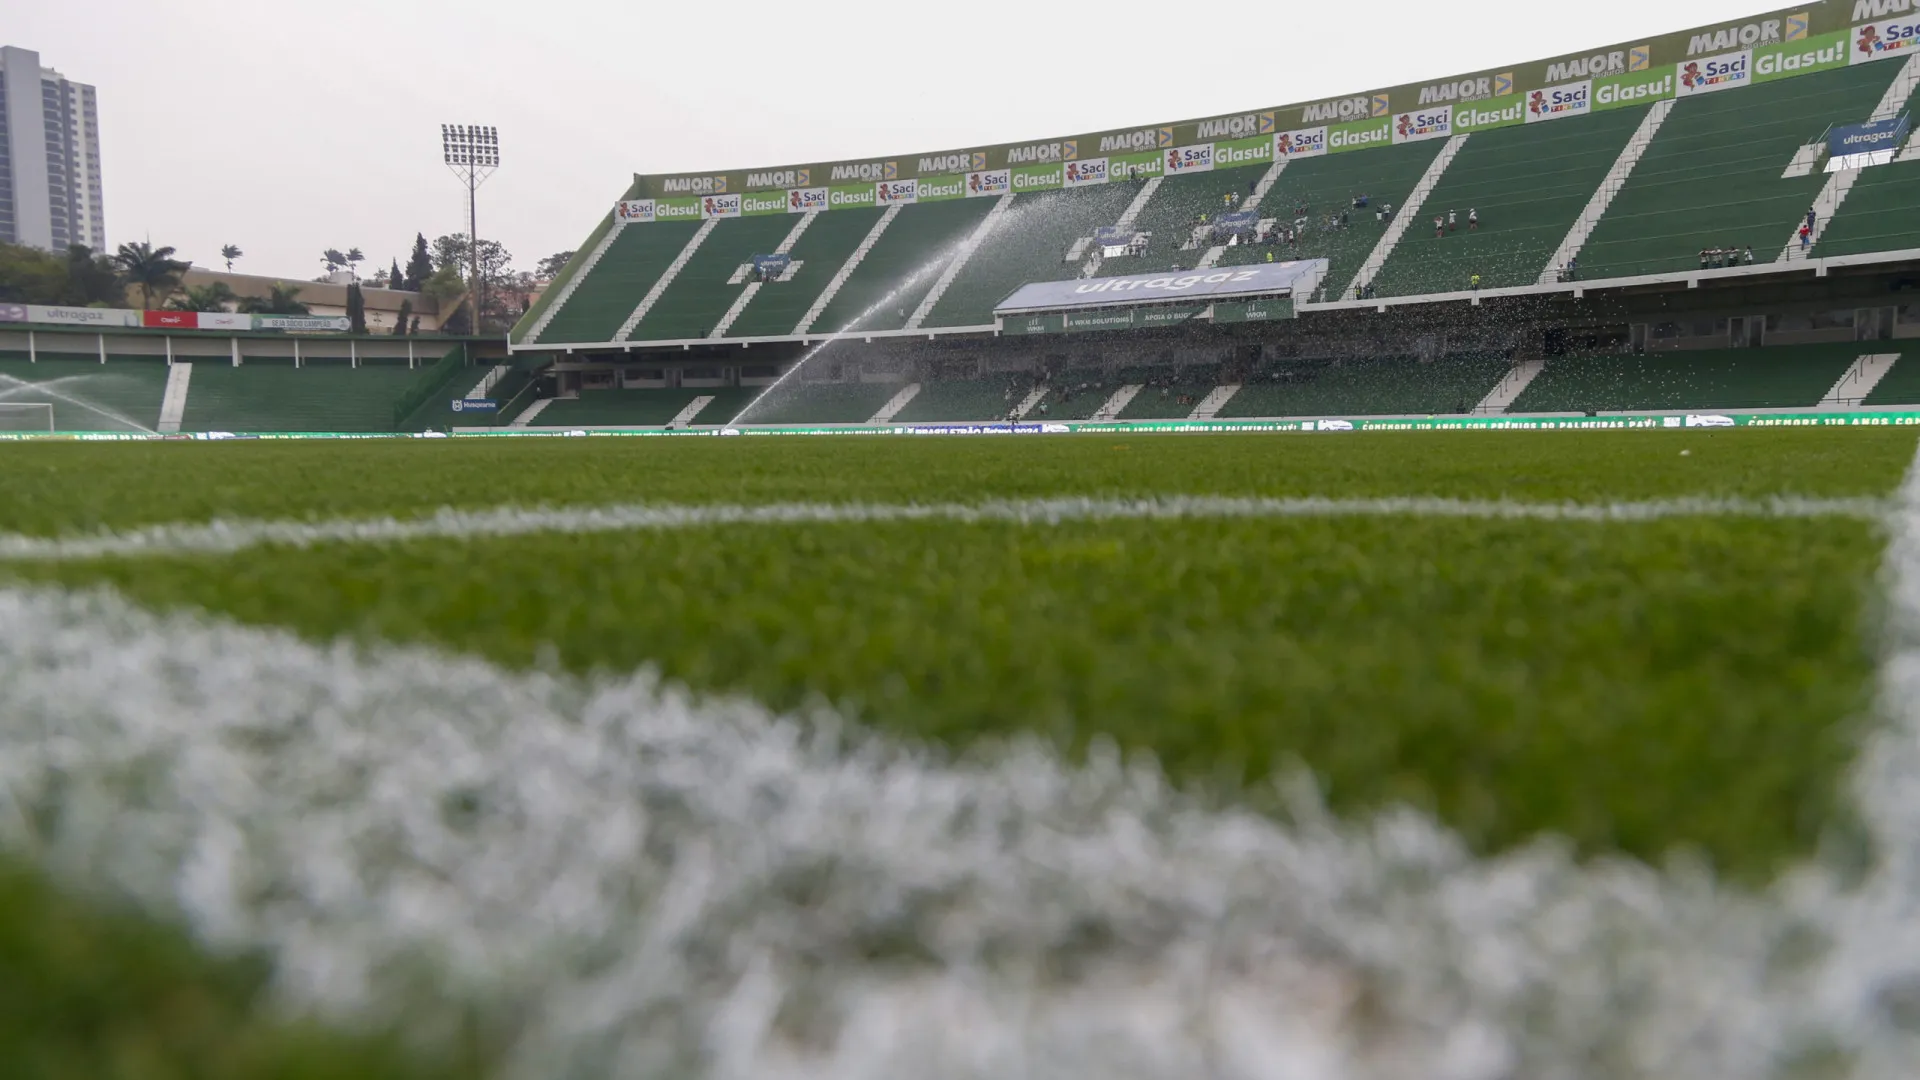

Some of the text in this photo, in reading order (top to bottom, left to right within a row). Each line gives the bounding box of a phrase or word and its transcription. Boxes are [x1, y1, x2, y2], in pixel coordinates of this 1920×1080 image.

[1852, 0, 1920, 21] MAI
[1686, 19, 1780, 56] MAIOR
[1742, 38, 1780, 50] seguros
[1706, 55, 1746, 76] Saci
[1756, 40, 1844, 75] Glasu!
[1544, 51, 1625, 82] MAIOR
[1592, 68, 1625, 79] seguros
[1705, 72, 1744, 85] TINTAS
[1418, 77, 1491, 104] MAIOR
[1552, 85, 1586, 104] Saci
[1596, 75, 1672, 103] Glasu!
[1302, 96, 1368, 122] MAIOR
[1456, 102, 1522, 128] Glasu!
[1551, 102, 1586, 112] TINTAS
[1196, 114, 1256, 138] MAIOR
[1416, 110, 1447, 127] Saci
[1100, 129, 1156, 152] MAIOR
[1296, 130, 1322, 146] Saci
[1330, 124, 1388, 147] Glasu!
[1844, 131, 1894, 144] ultragaz
[1007, 142, 1060, 162] MAIOR
[1184, 146, 1210, 160] Saci
[1216, 143, 1270, 163] Glasu!
[831, 163, 883, 180] MAIOR
[918, 154, 971, 172] MAIOR
[1082, 161, 1106, 174] Saci
[664, 177, 714, 192] MAIOR
[746, 170, 796, 187] MAIOR
[984, 172, 1007, 184] Saci
[1013, 170, 1060, 188] Glasu!
[804, 190, 825, 202] Saci
[831, 189, 874, 204] Glasu!
[892, 182, 914, 194] Saci
[918, 182, 962, 197] Glasu!
[632, 202, 652, 212] Saci
[656, 203, 699, 216] Glasu!
[717, 198, 738, 208] Saci
[744, 196, 785, 211] Glasu!
[1075, 270, 1260, 293] ultragaz
[46, 309, 104, 321] ultragaz
[1852, 418, 1889, 426] ANOS
